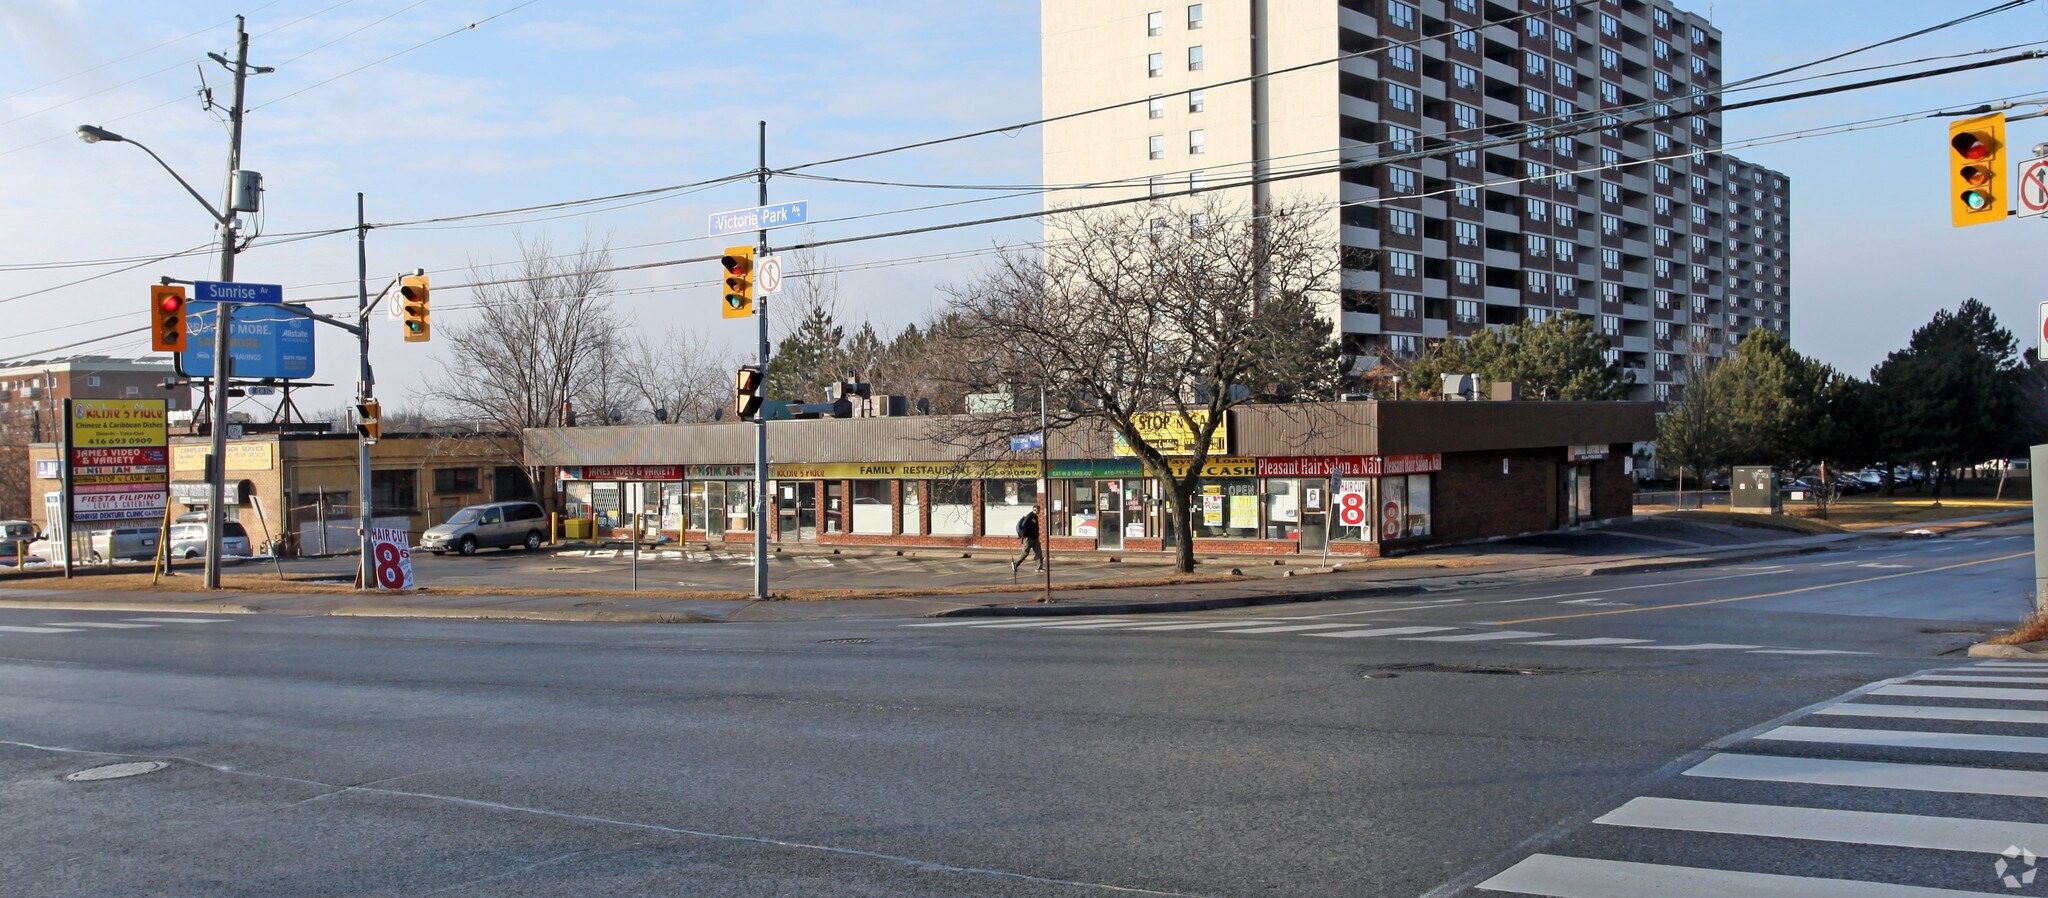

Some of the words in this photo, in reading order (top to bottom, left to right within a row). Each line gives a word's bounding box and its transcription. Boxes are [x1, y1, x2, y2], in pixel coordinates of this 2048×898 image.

[717, 212, 758, 230] Victoria
[763, 206, 788, 224] Park
[792, 204, 800, 213] Av
[210, 284, 256, 299] Sunrise
[238, 324, 272, 336] MORE.
[282, 328, 308, 338] Allstate
[133, 403, 164, 418] Place
[1138, 414, 1170, 430] STOP
[1030, 434, 1039, 442] Park
[76, 449, 108, 458] JAMES
[92, 456, 134, 464] VARIETY
[1258, 457, 1299, 475] Pleasant
[1301, 457, 1322, 475] Hair
[1324, 458, 1350, 475] Salon
[1353, 463, 1359, 474] &
[1362, 457, 1381, 474] Nail
[1383, 457, 1405, 474] Pleasant
[1405, 456, 1415, 472] Hair
[1415, 455, 1428, 471] Salon
[1432, 454, 1441, 470] Nail
[588, 467, 610, 476] JAMES
[612, 467, 634, 476] VIDEO
[637, 467, 641, 475] &
[644, 466, 676, 476] VARIETY
[860, 466, 896, 475] FAMILY
[903, 466, 971, 475] RESTAURT
[1228, 484, 1254, 496] OPEN
[81, 495, 116, 503] FIESTA
[119, 493, 160, 502] FILIPINO
[122, 500, 154, 508] CATERING
[1238, 496, 1251, 507] NO
[1341, 493, 1364, 524] 8
[74, 512, 98, 520] SUNRISE
[372, 528, 391, 541] HAIR
[392, 530, 407, 543] CUT
[376, 542, 404, 589] 8
